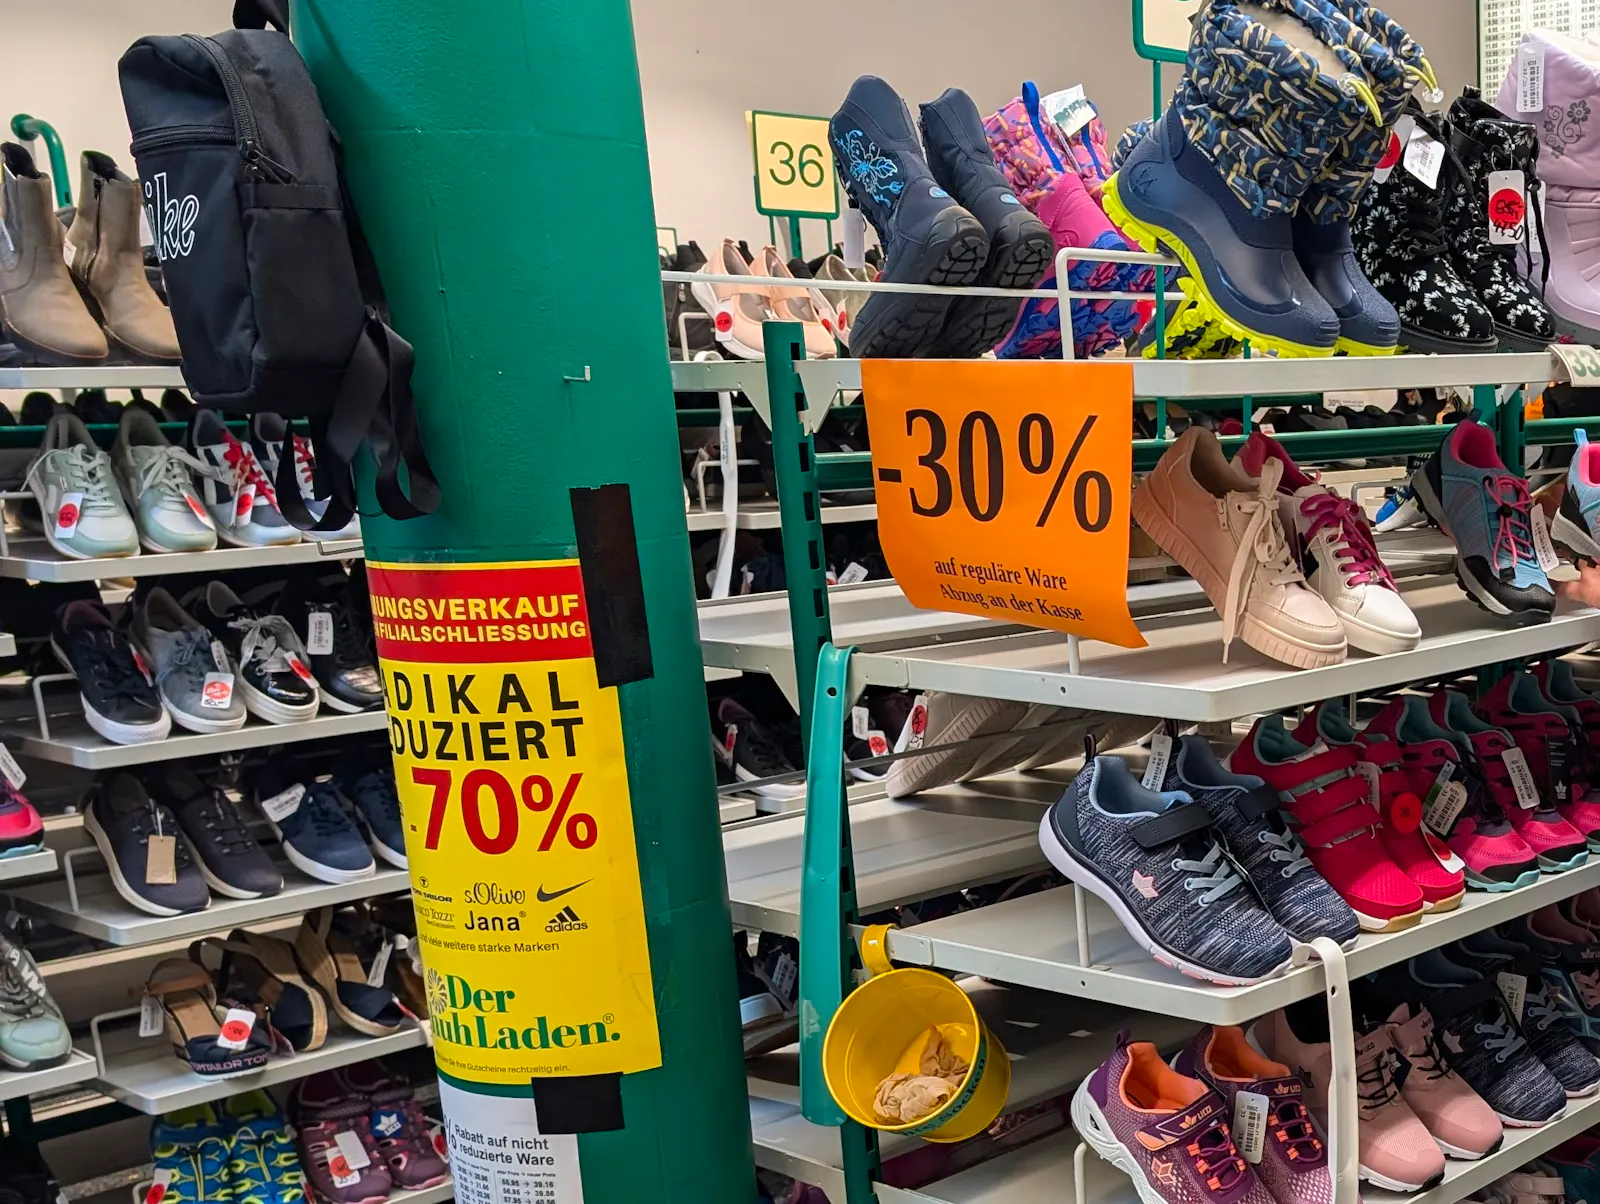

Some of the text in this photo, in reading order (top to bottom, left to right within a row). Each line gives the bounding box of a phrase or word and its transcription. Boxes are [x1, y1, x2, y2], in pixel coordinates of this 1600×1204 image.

[769, 141, 825, 188] 36
[878, 409, 1112, 532] -30%
[934, 557, 1067, 591] auf reguläre Ware
[940, 583, 1084, 621] Abzug an der Kasse
[378, 621, 586, 643] FILIALSCHLIESSUNG
[545, 920, 588, 933] adidas
[428, 935, 442, 947] viele
[443, 939, 476, 952] weitere
[478, 942, 511, 953] starke
[514, 941, 560, 953] Marken
[444, 973, 516, 1013] Der
[467, 1061, 507, 1074] Gutscheine
[508, 1064, 553, 1074] rechtzeitig
[455, 1124, 549, 1150] Rabatt auf nicht
[459, 1143, 513, 1164] reduzierte
[517, 1153, 555, 1165] Ware
